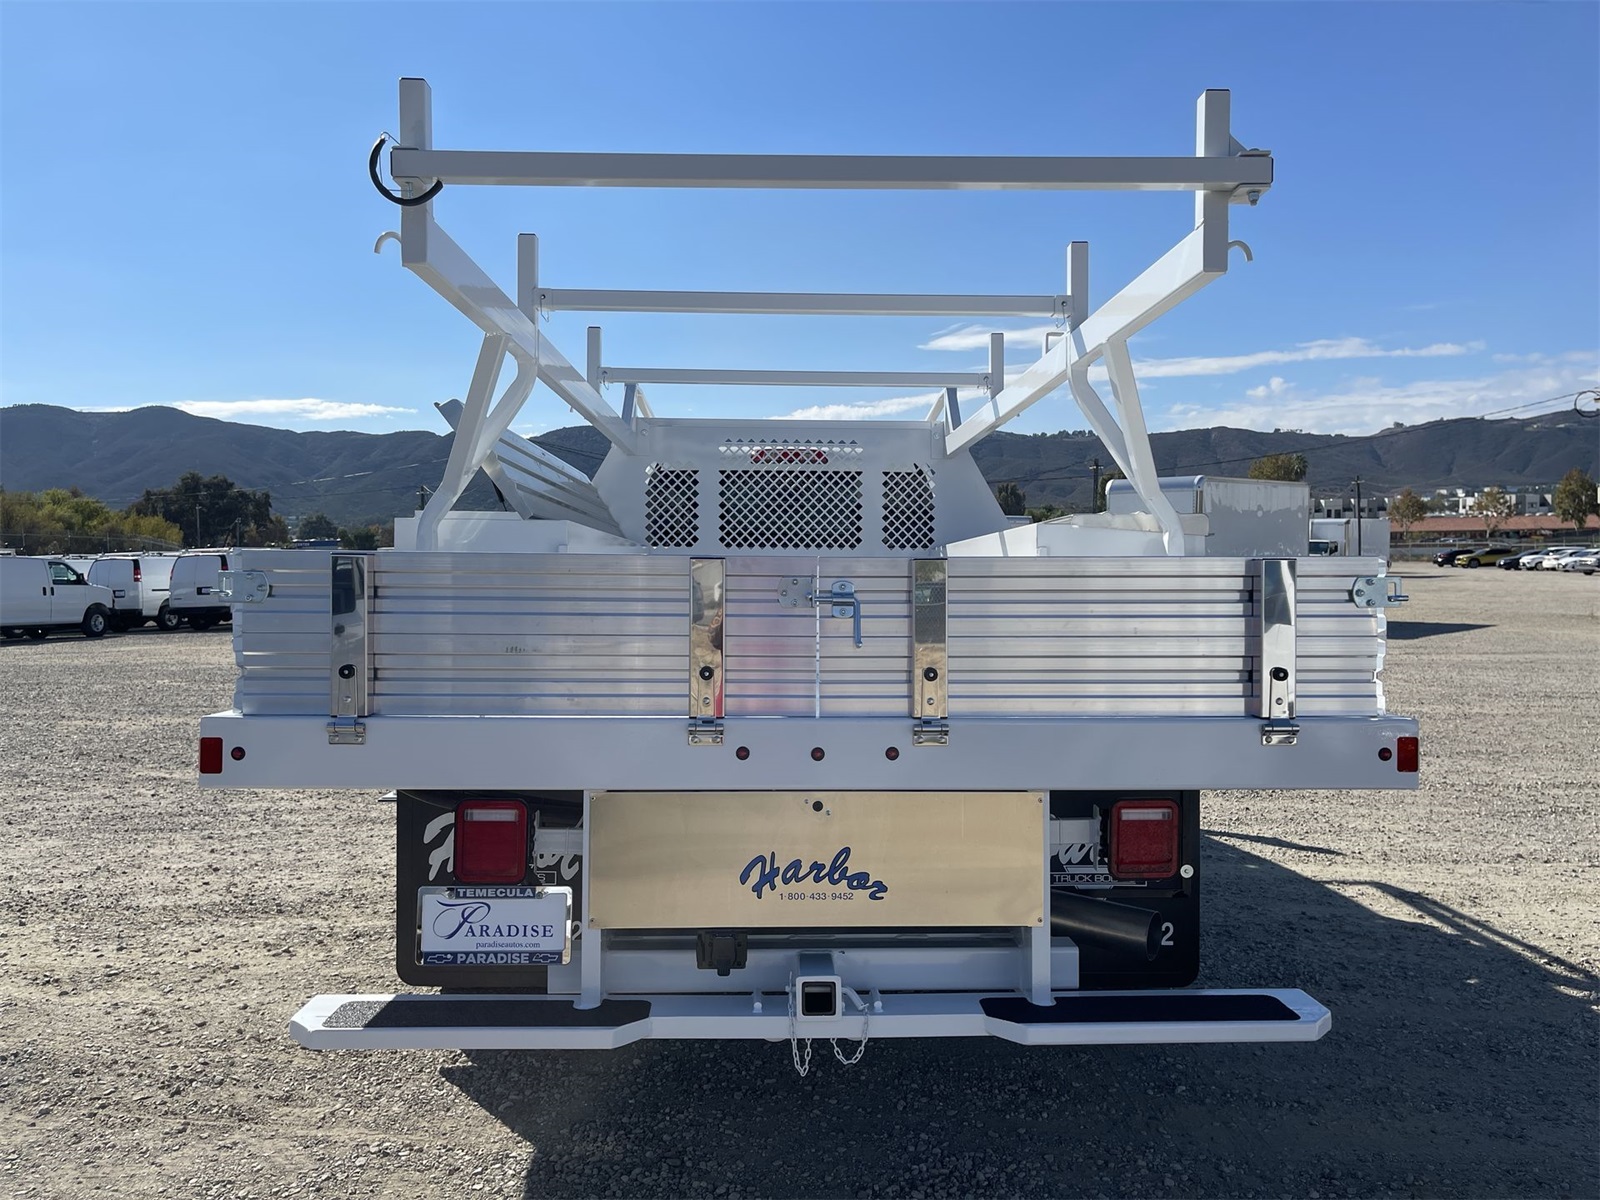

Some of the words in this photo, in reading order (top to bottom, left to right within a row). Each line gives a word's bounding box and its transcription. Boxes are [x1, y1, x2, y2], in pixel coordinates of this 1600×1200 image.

[739, 846, 888, 900] Harbor
[1053, 874, 1093, 883] TRUCK
[457, 888, 534, 897] TEMECULA
[475, 940, 541, 950] paradiseautos.com
[457, 953, 530, 964] PARADISE
